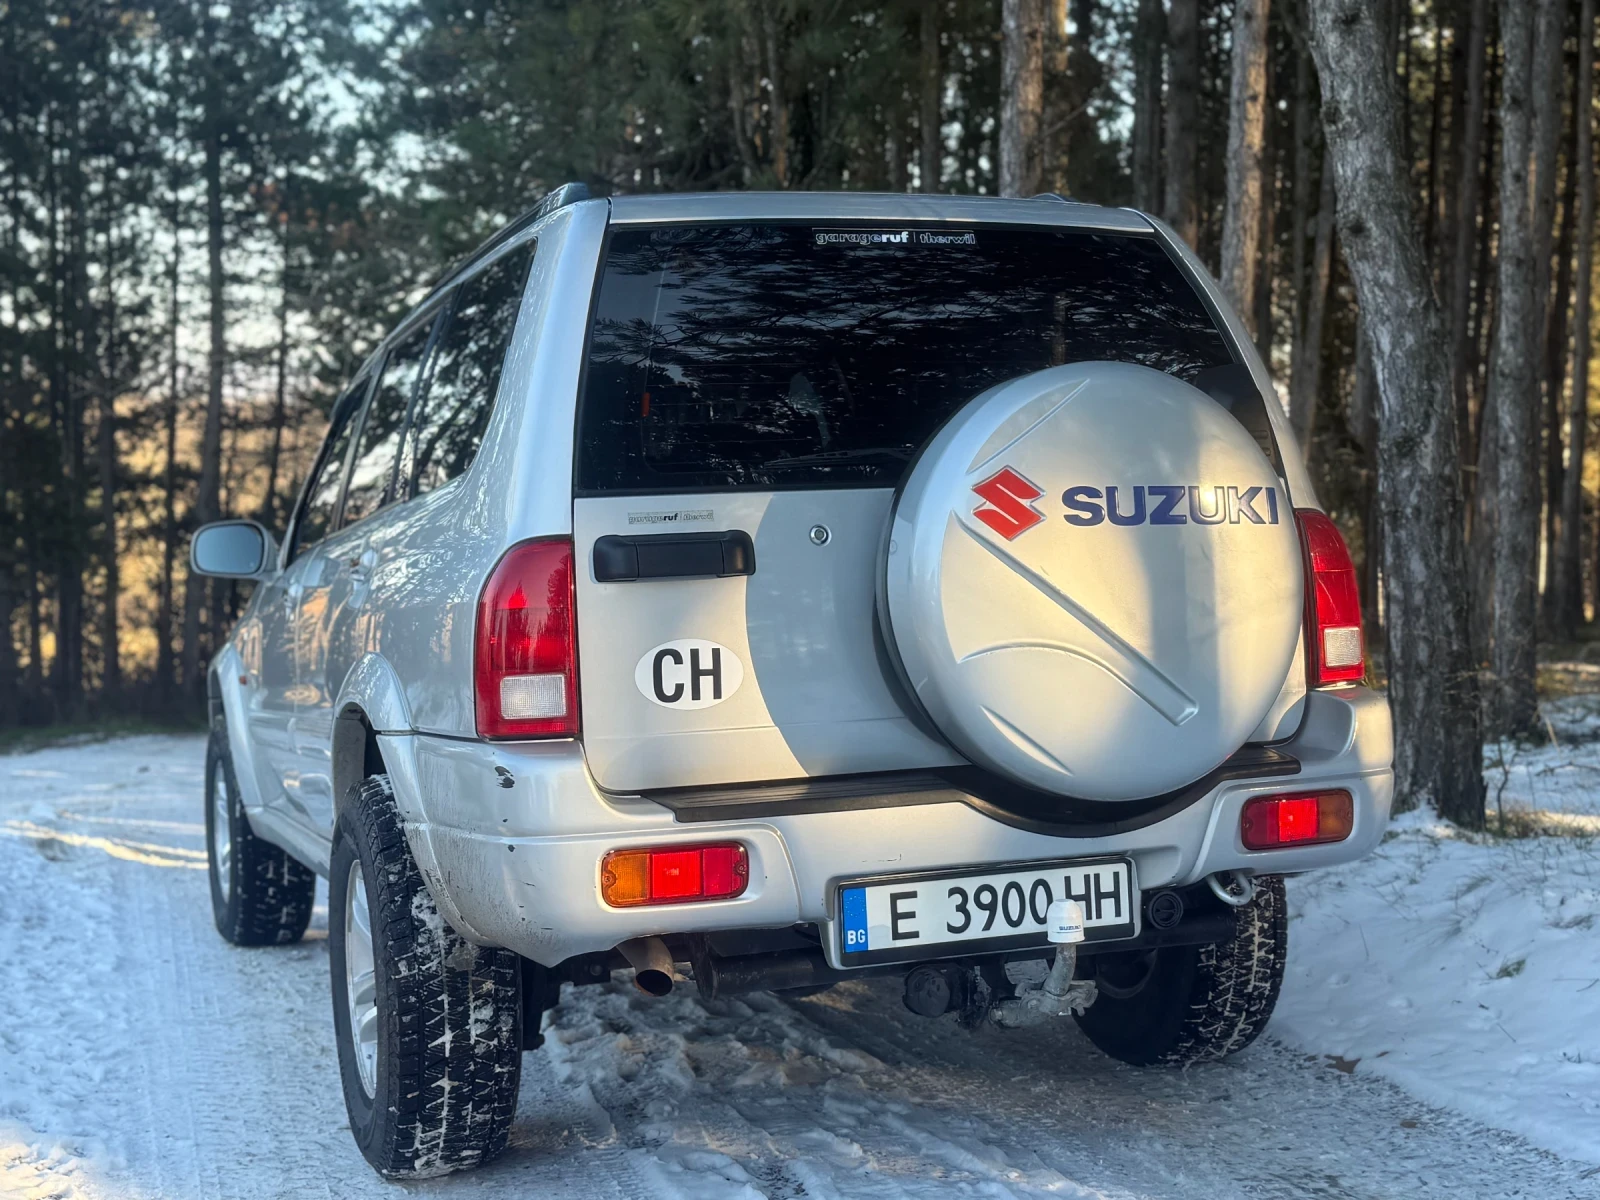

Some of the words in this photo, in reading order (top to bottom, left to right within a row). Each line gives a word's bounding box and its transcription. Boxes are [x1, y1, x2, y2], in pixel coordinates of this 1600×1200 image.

[919, 232, 976, 245] therwil
[1061, 485, 1279, 526] SUZUKI
[652, 647, 722, 703] CH
[889, 890, 920, 941] E
[946, 878, 1054, 934] 3900
[847, 929, 866, 945] BG
